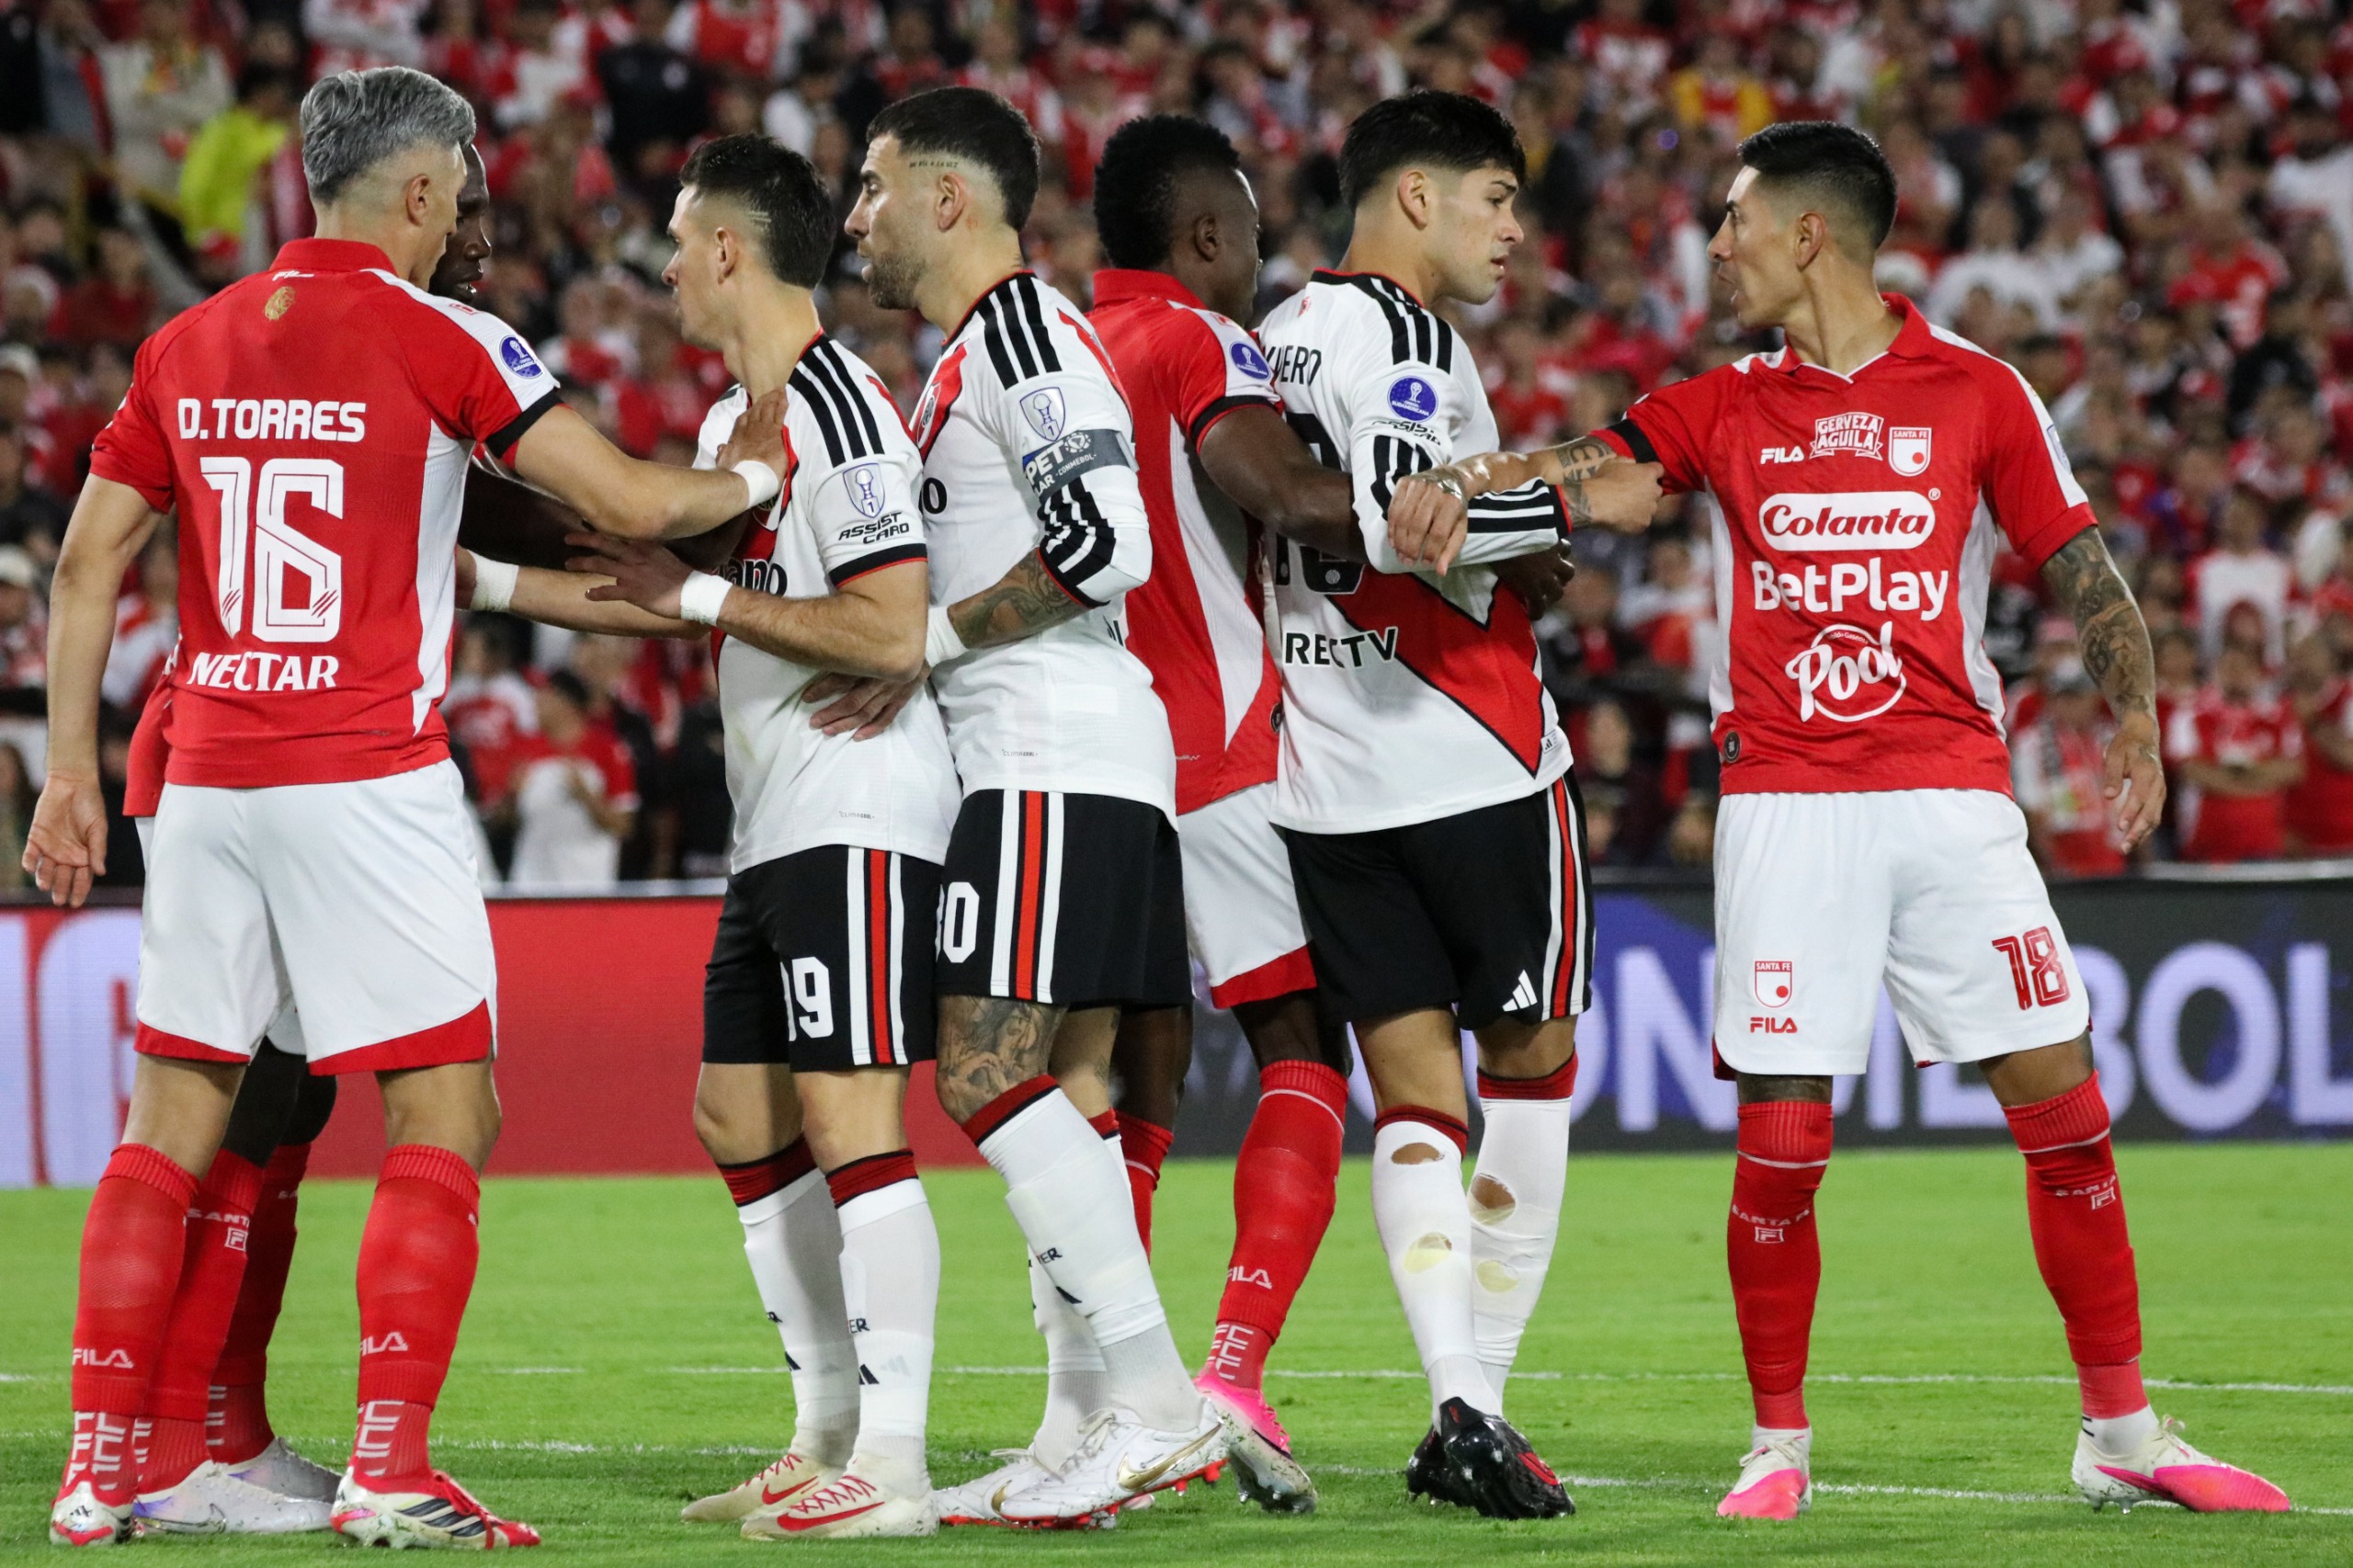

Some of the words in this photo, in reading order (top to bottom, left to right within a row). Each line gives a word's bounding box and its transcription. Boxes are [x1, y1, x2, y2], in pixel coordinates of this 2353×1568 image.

[178, 398, 366, 443] D.TORRES
[1893, 430, 1917, 439] SANTA
[1918, 431, 1927, 439] FE
[1760, 446, 1805, 465] FILA
[838, 511, 903, 541] ASSIST
[863, 522, 910, 544] CARD
[1763, 505, 1929, 537] Colanta
[199, 456, 345, 643] 16
[1751, 556, 1949, 621] BetPlay
[187, 651, 339, 691] NECTAR
[1785, 620, 1903, 722] Pool
[936, 881, 980, 963] 0
[1756, 962, 1780, 971] SANTA
[1781, 962, 1791, 971] FE
[1992, 926, 2071, 1011] 18
[1750, 1017, 1798, 1034] FILA
